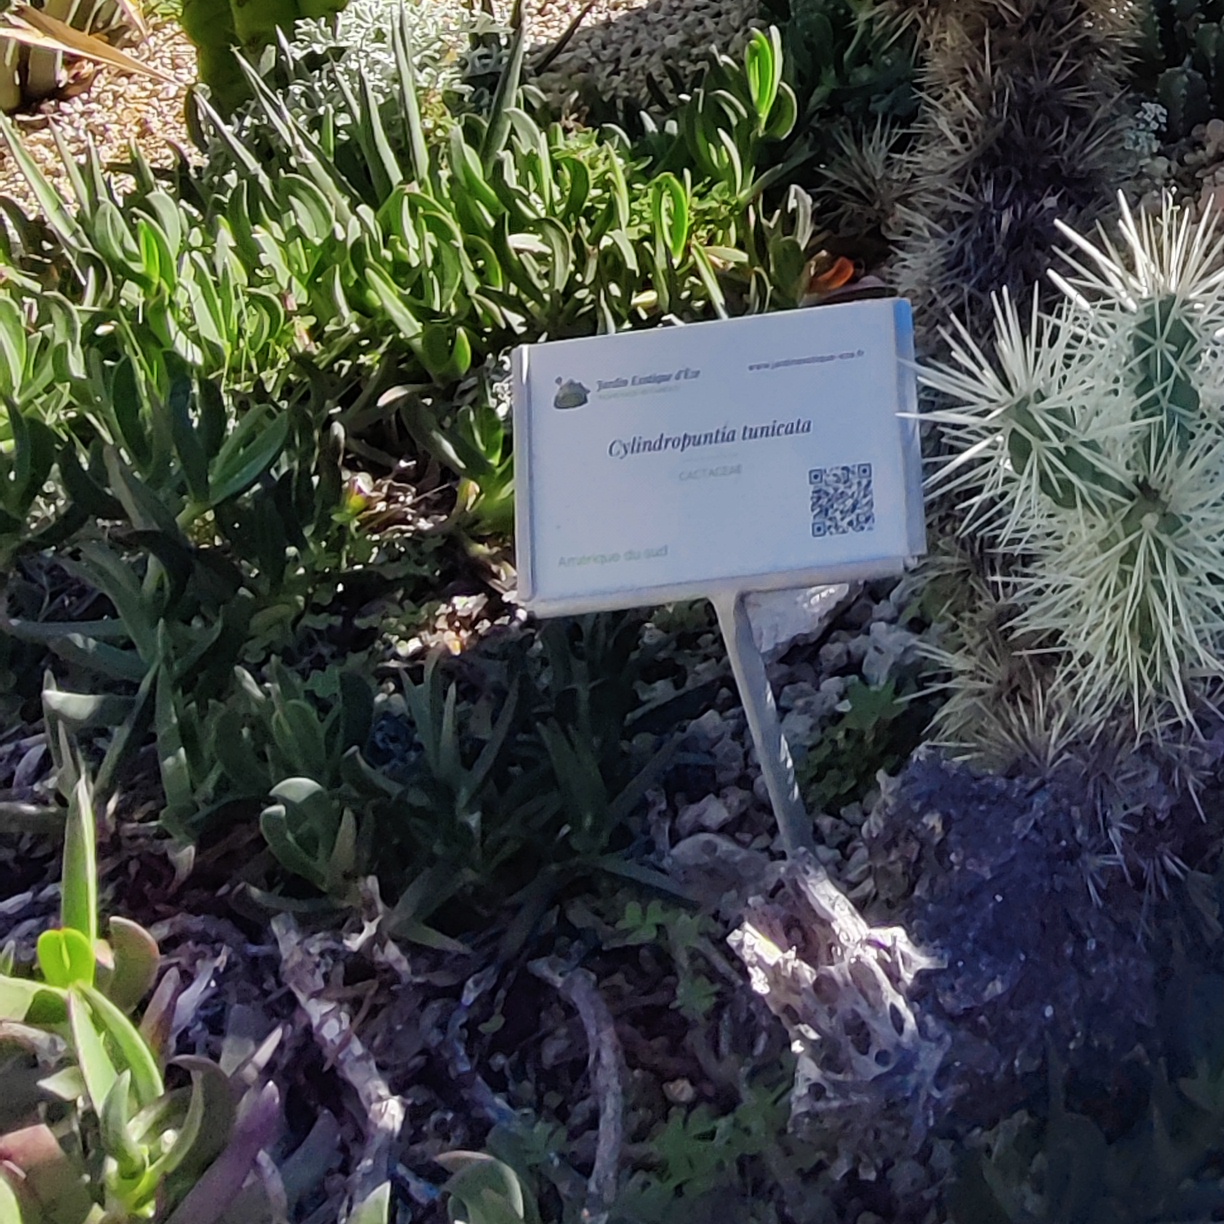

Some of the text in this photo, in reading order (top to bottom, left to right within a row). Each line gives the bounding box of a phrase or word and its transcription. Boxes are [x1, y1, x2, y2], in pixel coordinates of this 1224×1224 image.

[597, 378, 628, 392] Jardin
[631, 373, 673, 387] Exotique
[608, 418, 812, 459] Cylindropuntia tunicata
[678, 464, 742, 482] CACTACEAE
[623, 549, 640, 562] du
